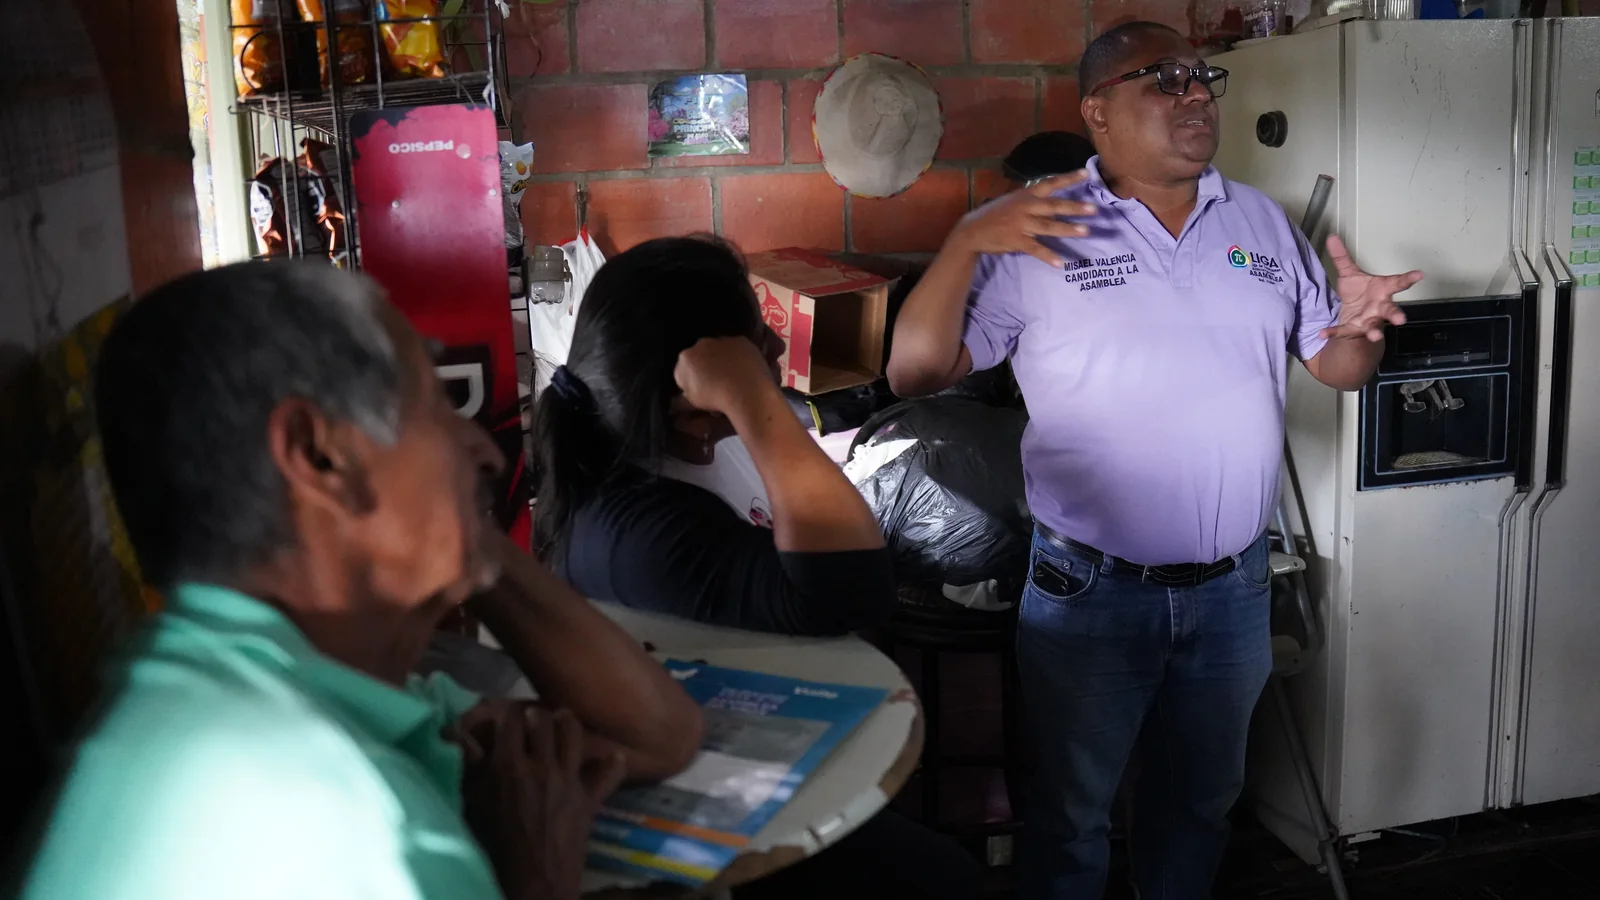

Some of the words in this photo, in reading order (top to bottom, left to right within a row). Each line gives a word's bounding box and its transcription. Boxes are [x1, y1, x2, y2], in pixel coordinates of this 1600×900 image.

[388, 139, 454, 154] PEPSICO
[1064, 258, 1094, 271] MISAEL
[1095, 253, 1136, 267] VALENCIA
[1249, 251, 1279, 268] LIGA
[1065, 268, 1114, 283] CANDIDATO
[1117, 266, 1123, 275] A
[1126, 264, 1139, 274] LA
[1080, 277, 1126, 291] ASAMBLEA
